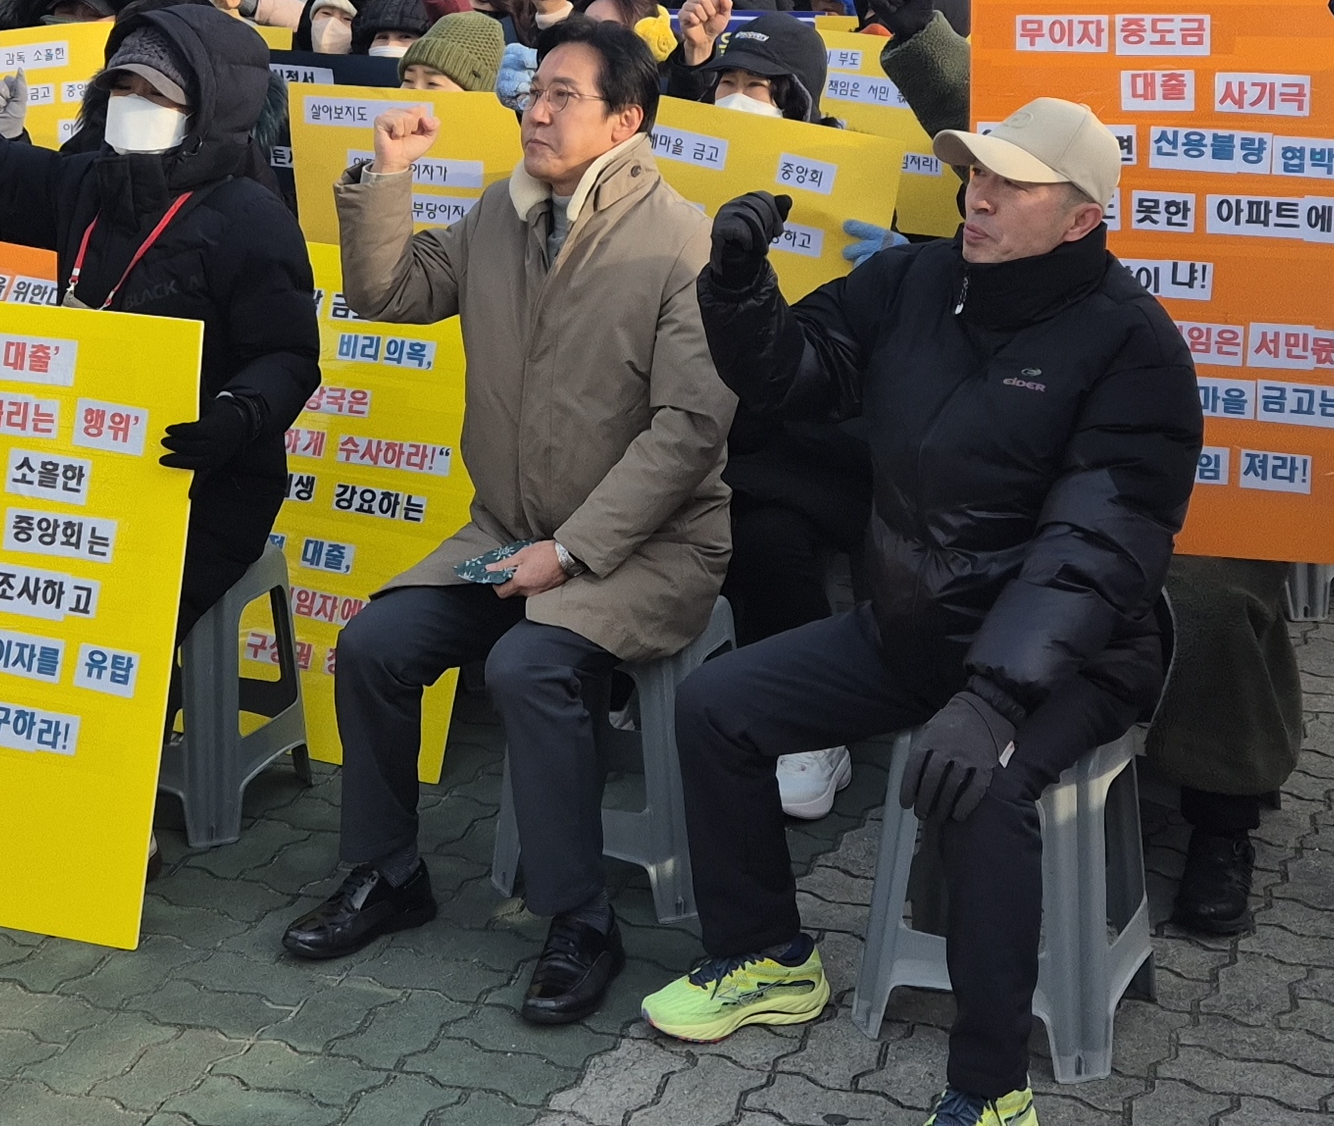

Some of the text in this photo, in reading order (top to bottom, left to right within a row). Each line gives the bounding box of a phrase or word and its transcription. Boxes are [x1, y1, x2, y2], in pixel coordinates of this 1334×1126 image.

[1019, 17, 1207, 50] 무이자 중도금
[5, 47, 65, 66] 감독 소홀한
[838, 51, 860, 66] 부도
[828, 79, 860, 98] 책임은
[867, 84, 890, 102] 서민
[1130, 72, 1308, 112] 대출 사기극
[310, 103, 368, 122] 살아보지도
[693, 143, 719, 164] 금고
[1153, 129, 1267, 165] 신용불량
[780, 161, 824, 188] 중앙회
[1135, 196, 1333, 233] 못한 아파트에
[1178, 326, 1241, 355] 임은
[11, 455, 86, 494] 소홀한
[1243, 452, 1308, 483] 져라!
[286, 472, 424, 523] 생 강요하는
[11, 513, 110, 558] 중앙회는
[300, 537, 352, 574] 대출,
[84, 648, 134, 686] 유탑
